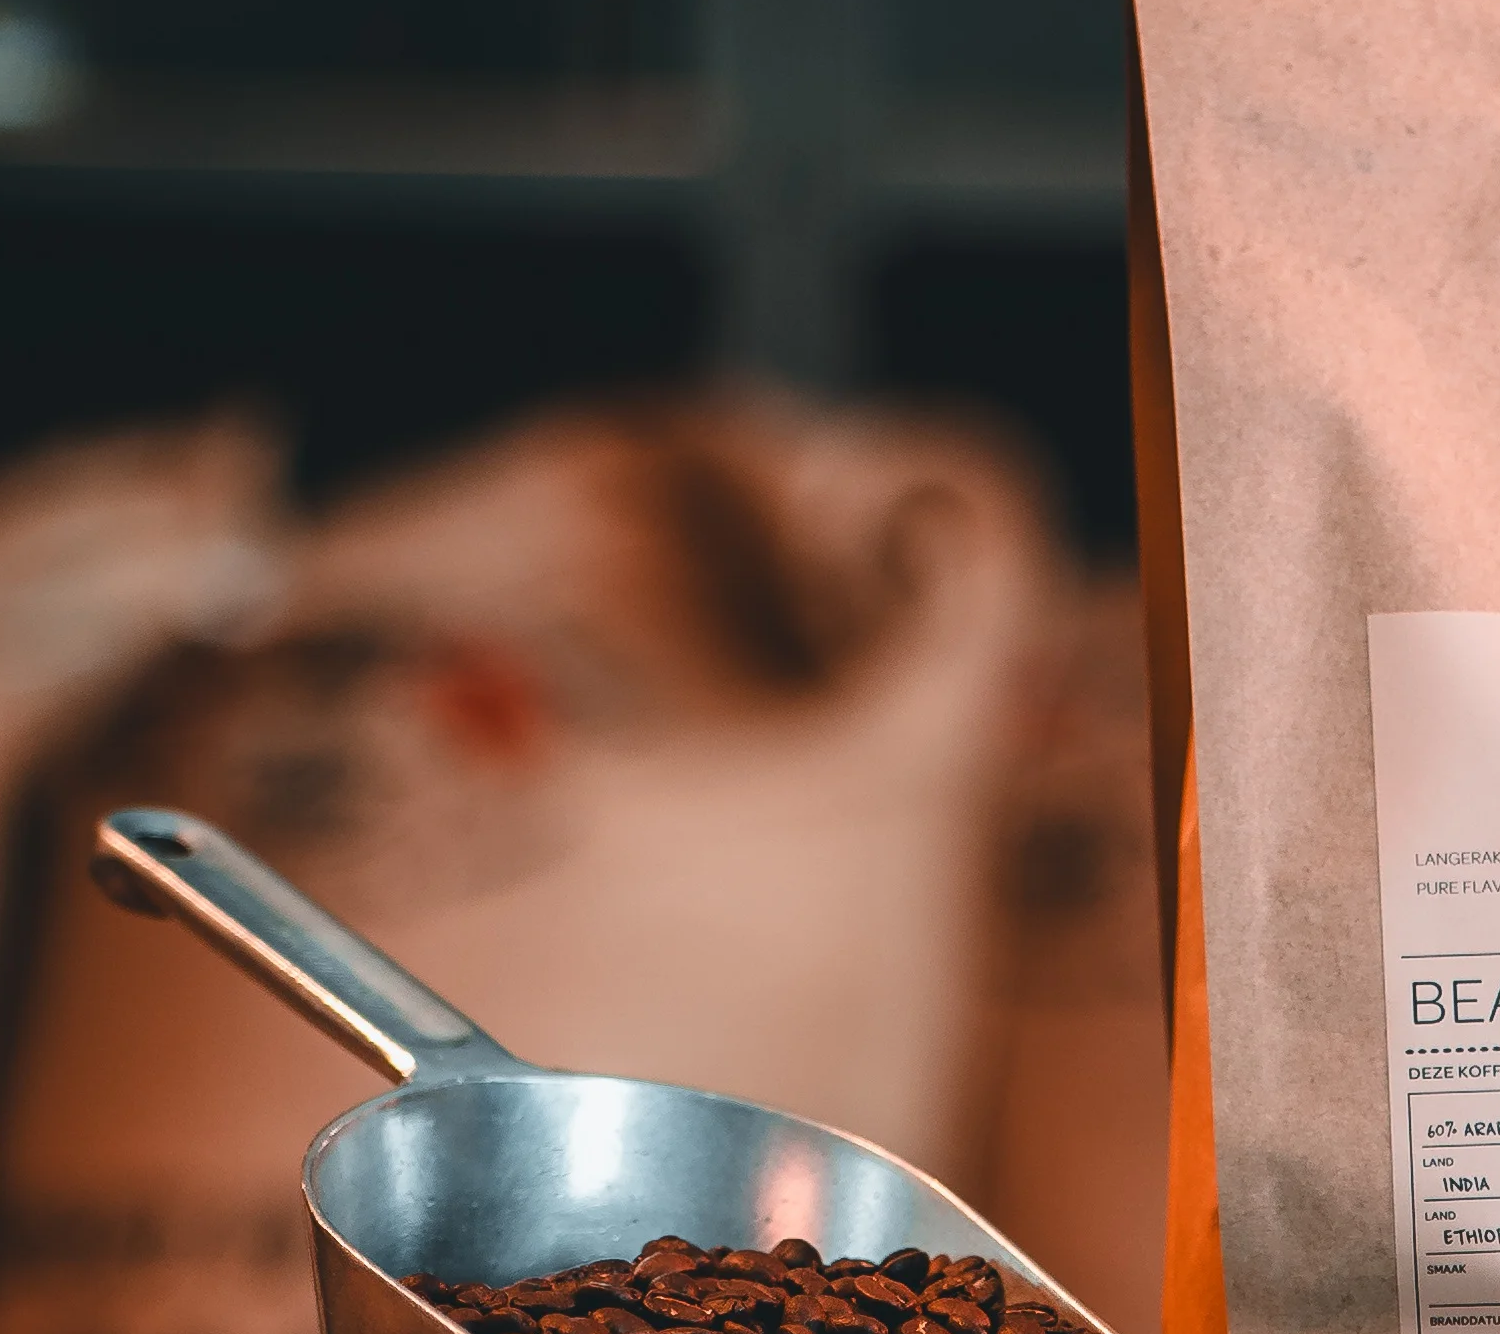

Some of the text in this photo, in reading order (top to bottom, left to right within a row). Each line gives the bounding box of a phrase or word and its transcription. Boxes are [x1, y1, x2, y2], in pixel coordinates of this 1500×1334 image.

[1416, 881, 1459, 895] PURE
[1408, 1067, 1454, 1080] DEZE
[1427, 1120, 1458, 1138] 60%
[1423, 1157, 1454, 1167] LAND
[1443, 1176, 1490, 1192] INDIA
[1424, 1211, 1456, 1221] LAND
[1426, 1264, 1466, 1275] SMAAK
